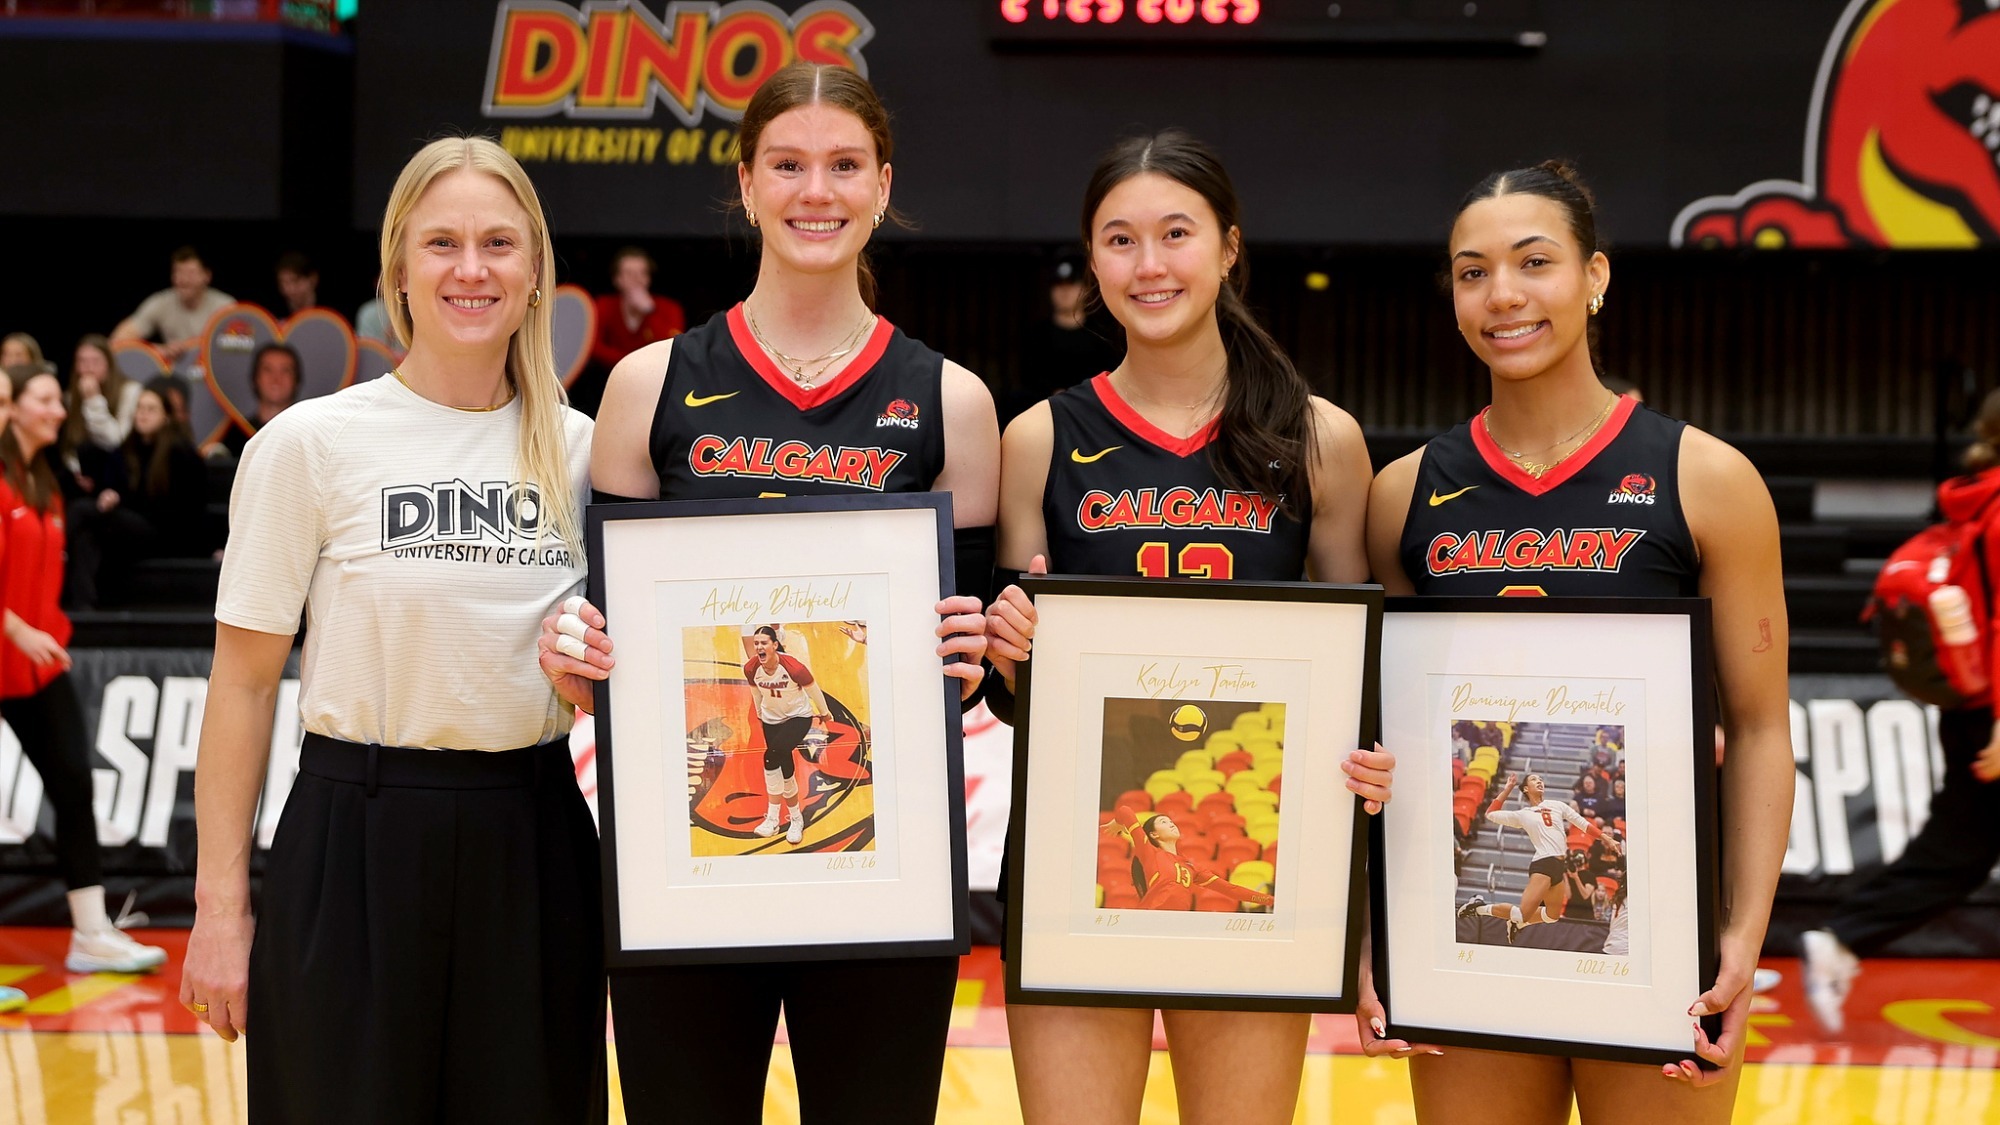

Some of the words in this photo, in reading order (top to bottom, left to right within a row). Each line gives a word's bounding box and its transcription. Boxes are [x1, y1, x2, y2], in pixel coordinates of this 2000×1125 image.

[485, 1, 870, 124] DINOS
[502, 125, 663, 163] UNIVERSITY
[667, 127, 705, 164] OF
[876, 416, 919, 429] DINOS
[688, 434, 907, 491] CALGARY
[381, 478, 568, 550] DINO
[1077, 486, 1286, 534] CALGARY
[1608, 492, 1656, 505] DINOS
[394, 544, 491, 563] UNIVERSITY
[496, 546, 515, 565] OF
[1426, 528, 1647, 577] CALGARY
[701, 585, 762, 624] Ashley
[768, 581, 852, 618] Ditchfield
[1137, 662, 1200, 699] Kaylyn
[1202, 664, 1257, 698] Tanton
[1451, 682, 1540, 723] Dominique
[1546, 685, 1626, 715] Desautels
[826, 855, 875, 870] 2025-26
[1174, 862, 1191, 888] 13
[1225, 918, 1275, 932] 2021-26
[1576, 959, 1629, 976] 2022-26
